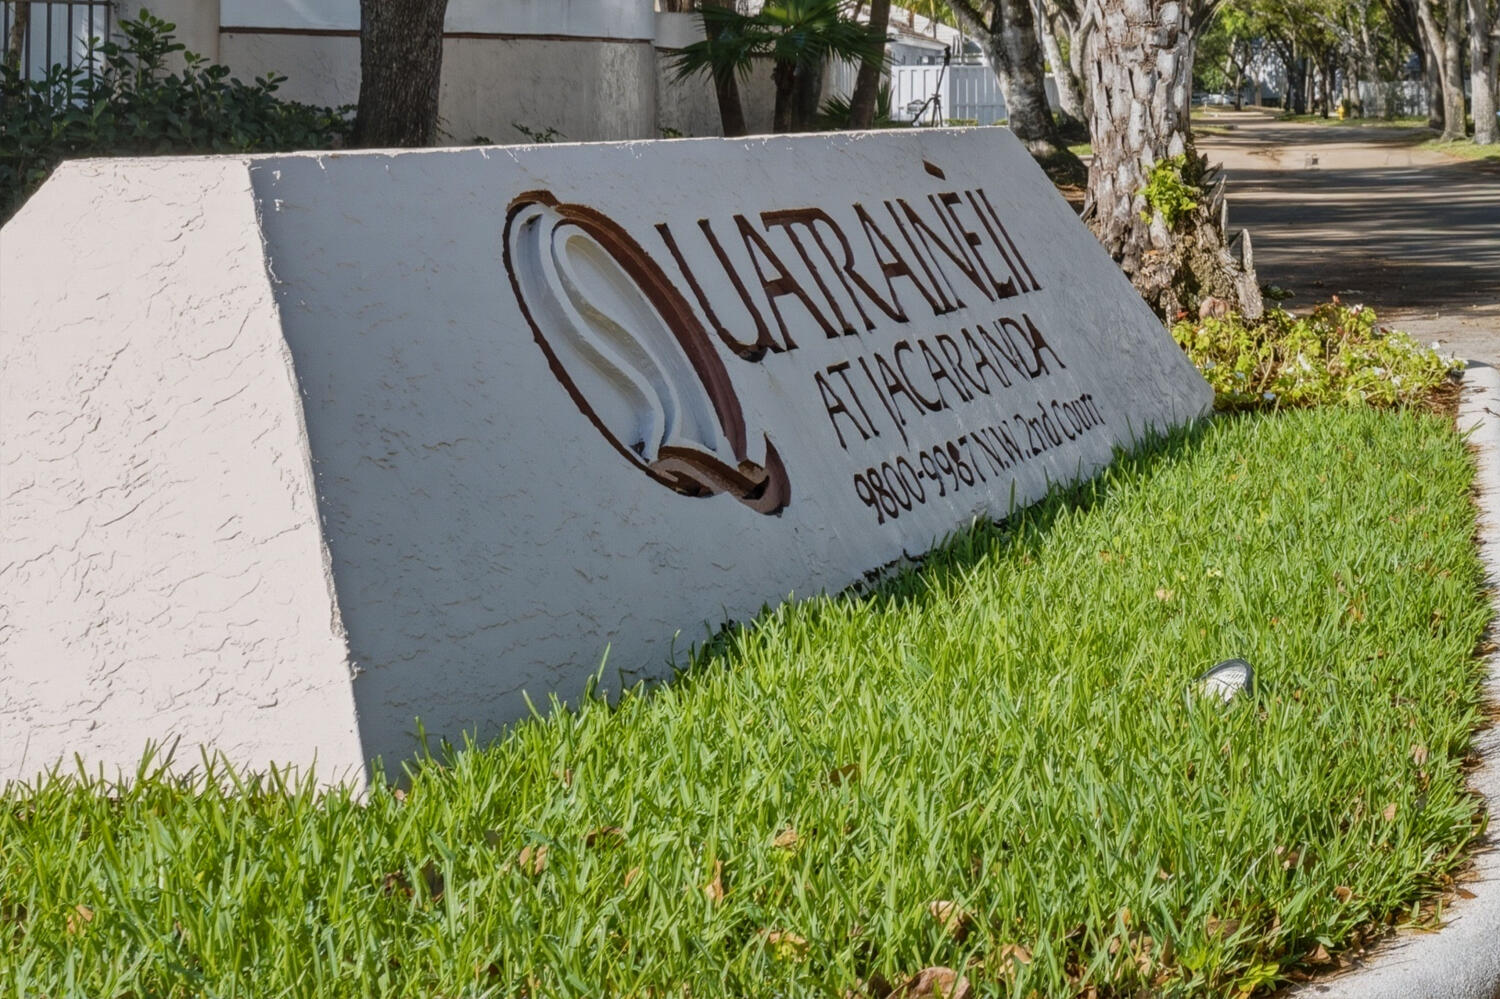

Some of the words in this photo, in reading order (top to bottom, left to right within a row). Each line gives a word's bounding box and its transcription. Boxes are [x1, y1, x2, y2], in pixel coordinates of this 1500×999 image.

[814, 361, 880, 450] AT
[858, 313, 1066, 450] JACARANDA
[1051, 394, 1106, 441] Court
